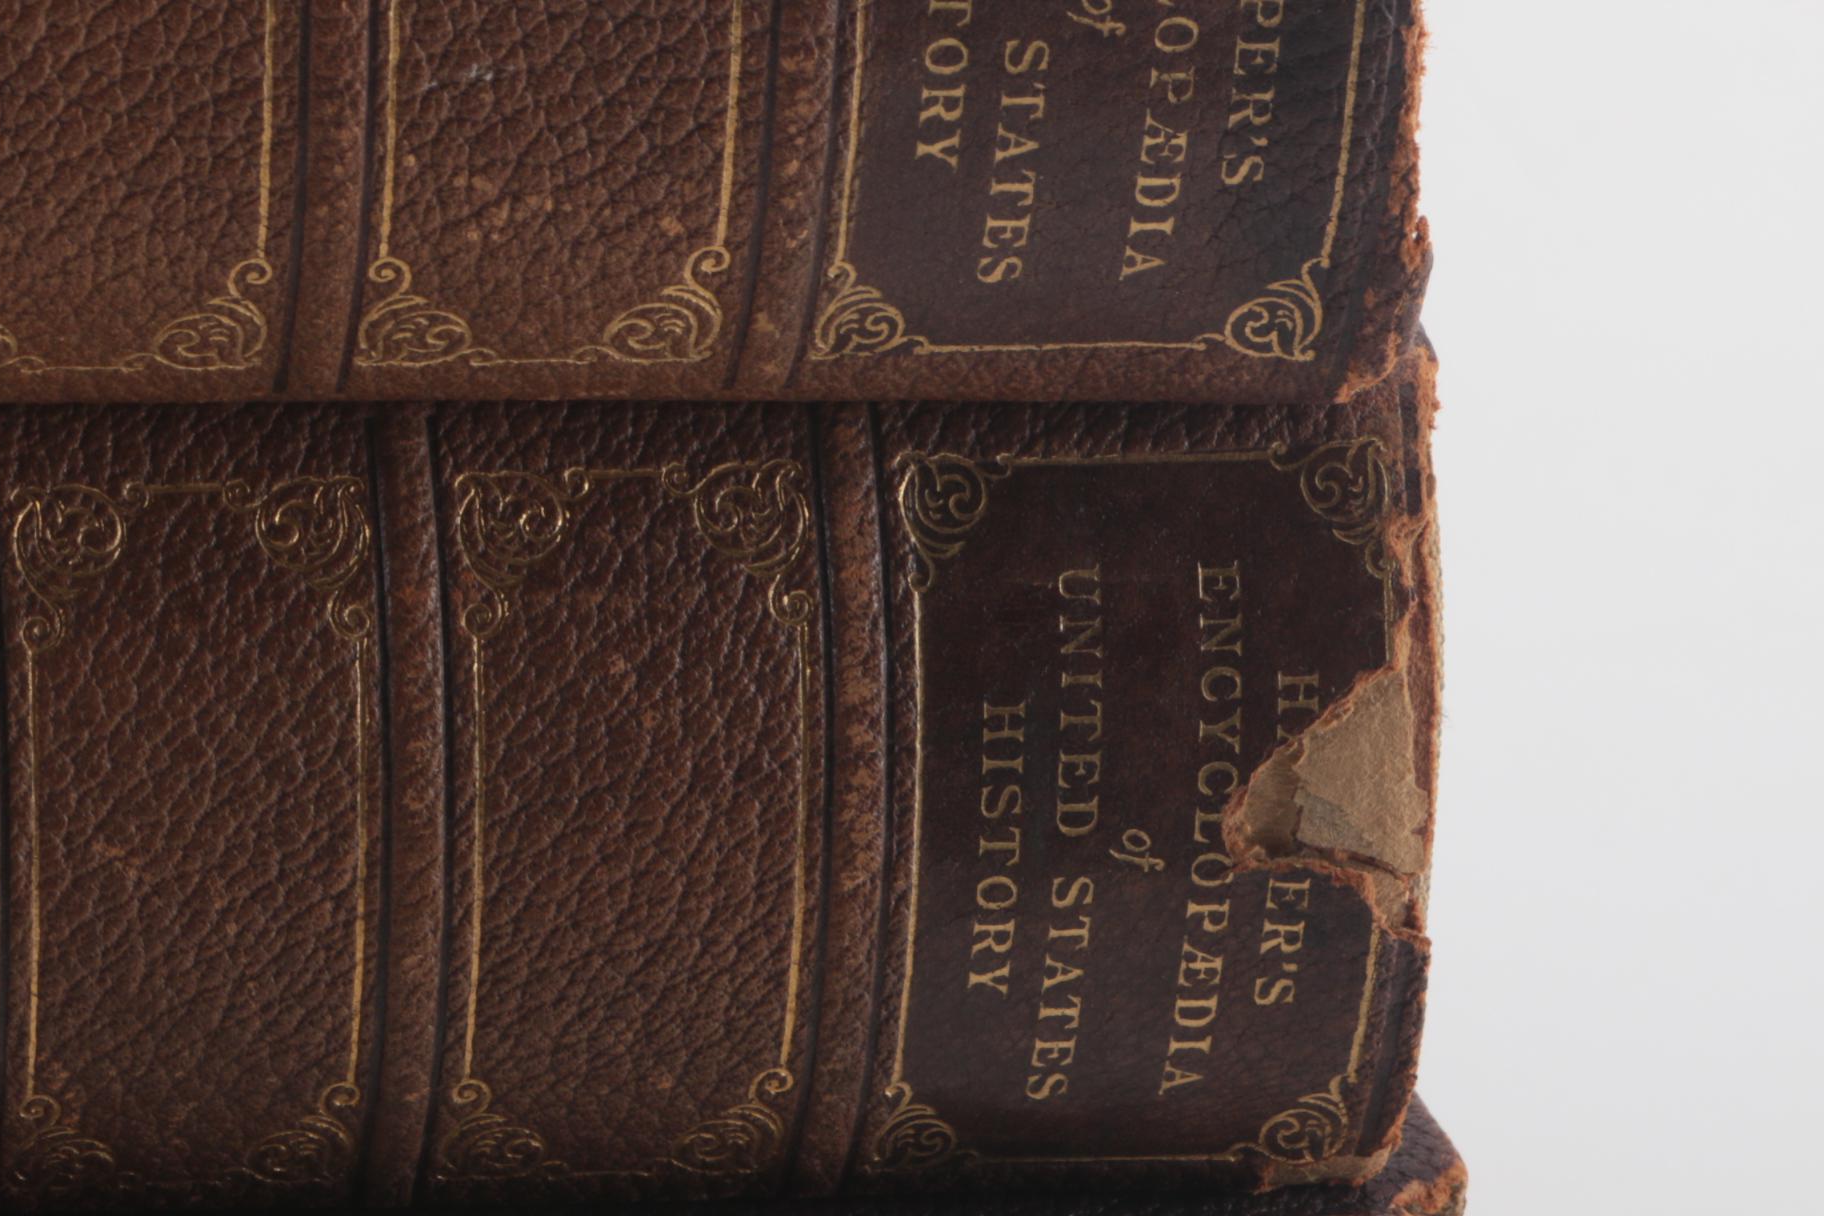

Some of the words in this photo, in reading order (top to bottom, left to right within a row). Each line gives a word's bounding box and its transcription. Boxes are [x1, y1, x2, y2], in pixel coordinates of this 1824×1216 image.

[977, 40, 1049, 283] STATES
[1119, 0, 1199, 281] OPÆDIA
[1056, 564, 1102, 836] UNITED
[1159, 560, 1241, 1095] ENCYCLOPÆDIA
[1254, 670, 1319, 1006] HER'S
[967, 702, 1025, 994] HISTORY
[1109, 828, 1165, 872] of
[1026, 876, 1094, 1100] STATES
